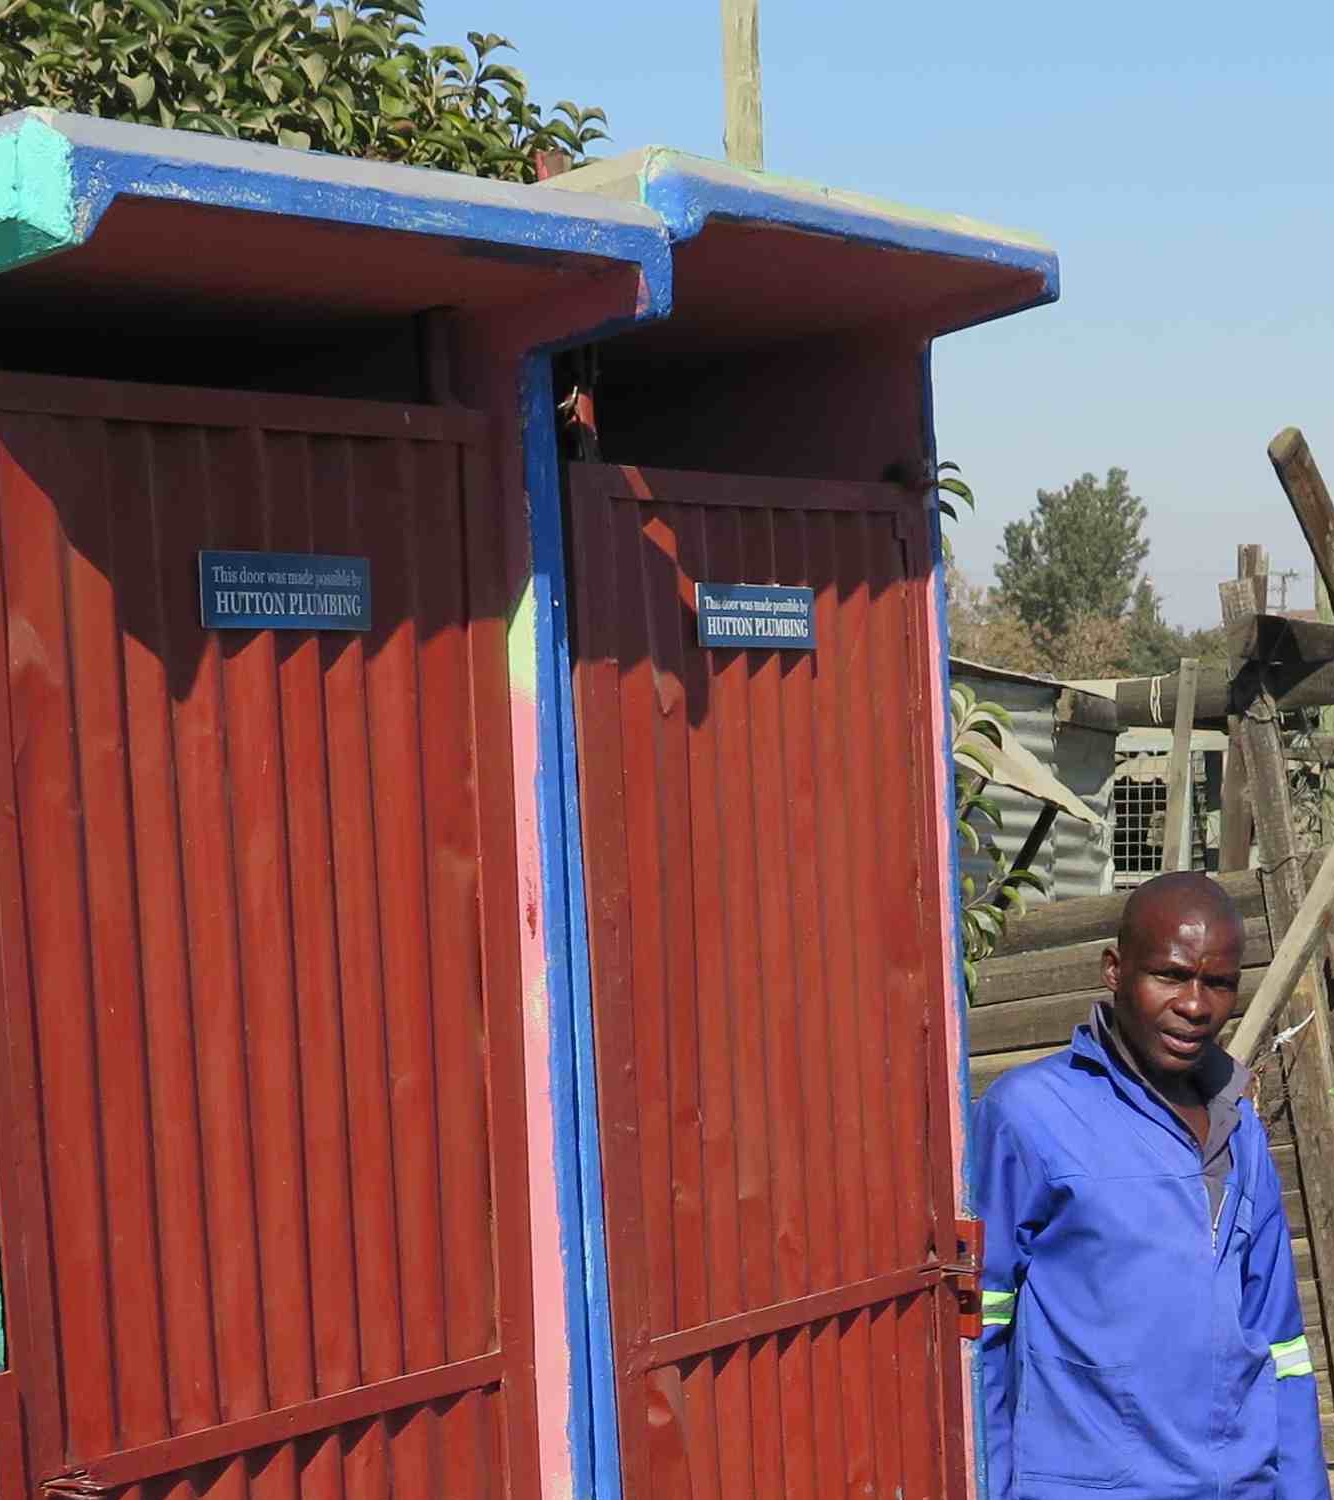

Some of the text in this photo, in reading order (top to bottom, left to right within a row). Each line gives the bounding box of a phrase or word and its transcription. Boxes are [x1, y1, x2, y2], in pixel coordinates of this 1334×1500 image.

[211, 566, 362, 591] This door was made possible by
[215, 591, 362, 616] HUTTON PLUMBING
[704, 595, 809, 616] This door was made possible by
[707, 616, 809, 638] HUTTON PLUMBING
